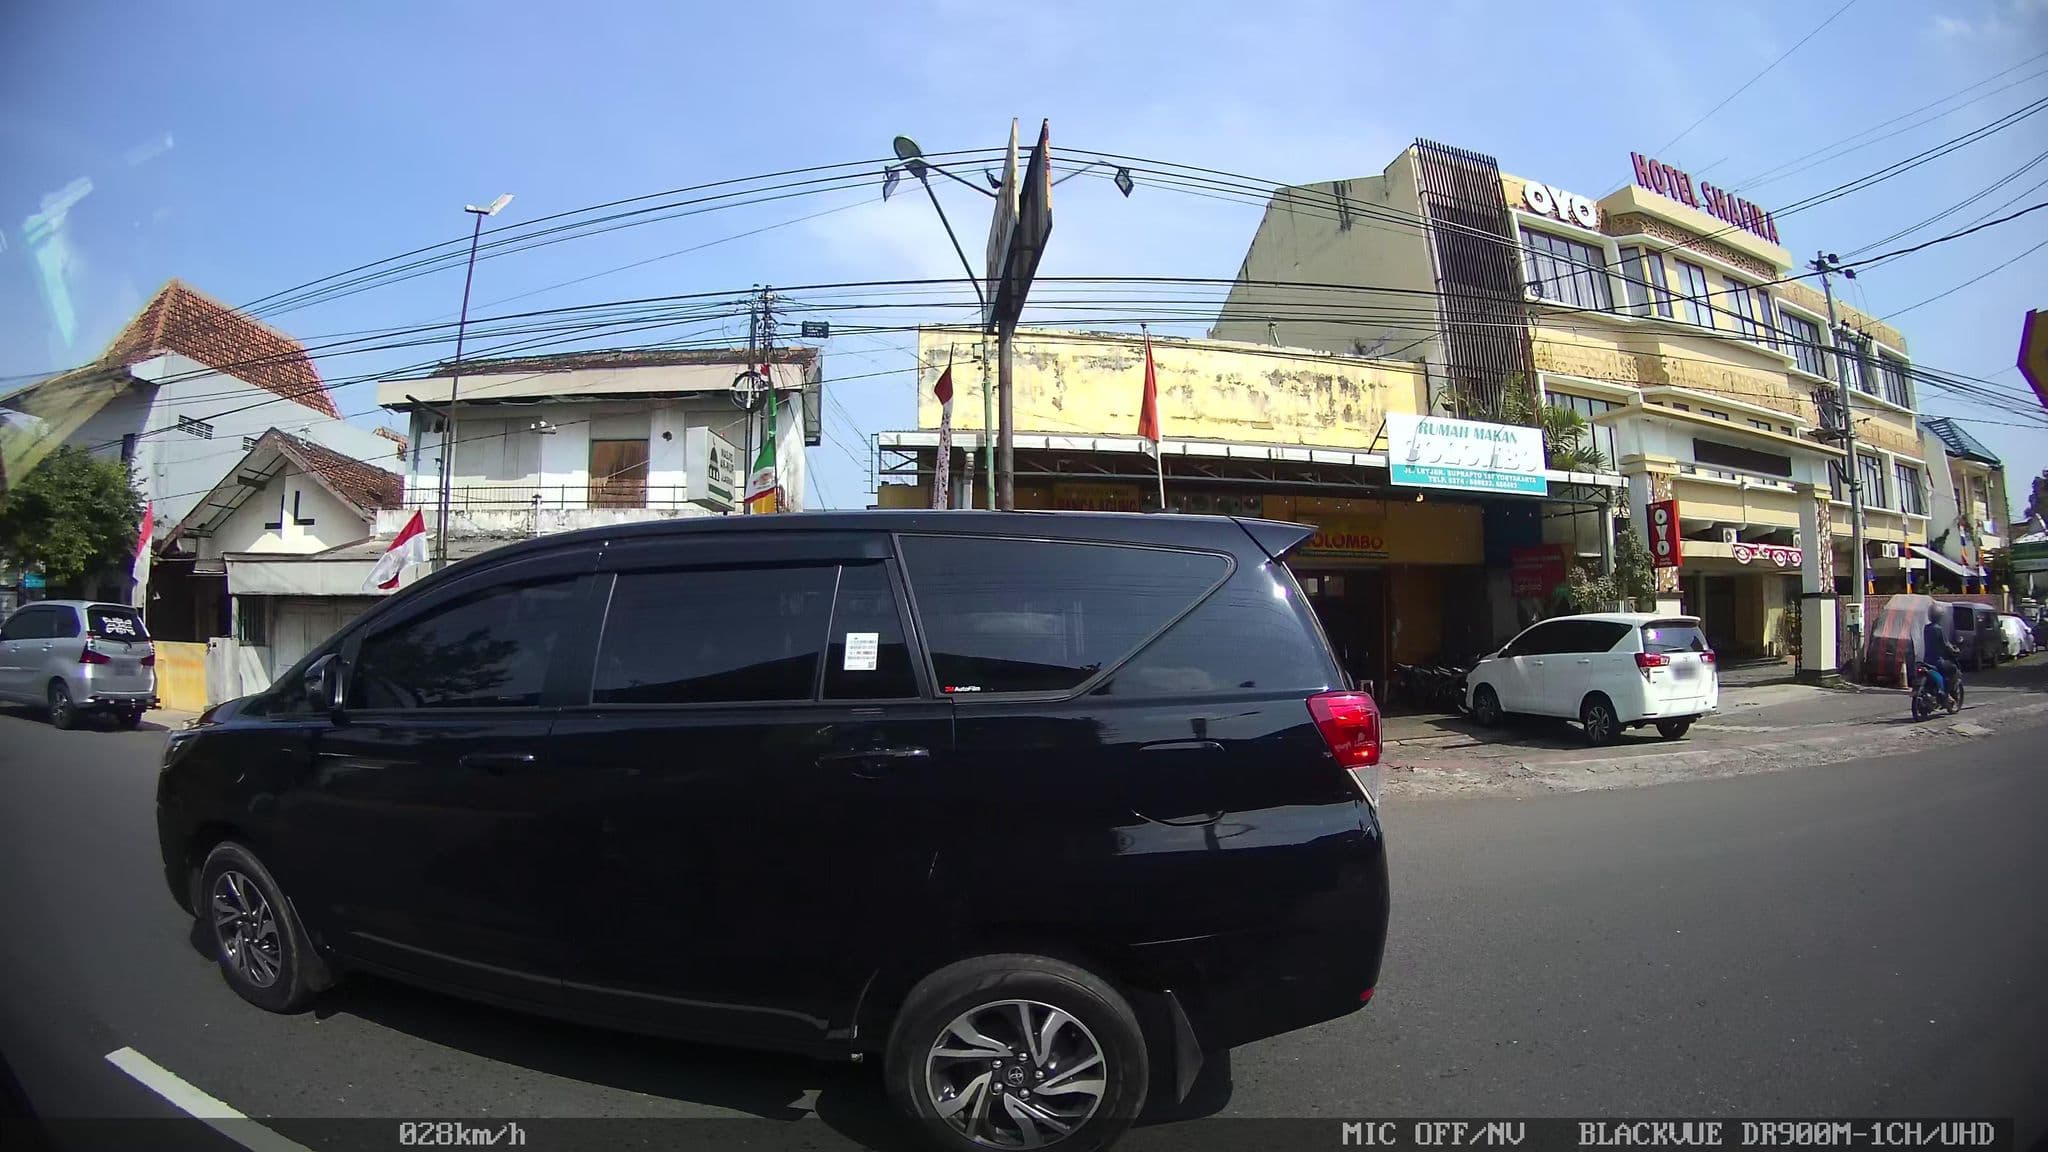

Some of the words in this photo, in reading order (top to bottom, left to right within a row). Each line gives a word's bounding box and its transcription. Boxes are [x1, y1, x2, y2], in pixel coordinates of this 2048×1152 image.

[1522, 181, 1598, 229] OYO
[1631, 152, 1700, 210] HOTEL
[1701, 181, 1780, 246] SHAFIRA
[1417, 422, 1469, 439] RUMAH
[1474, 428, 1518, 444] MAKAN
[1654, 509, 1670, 556] OYO
